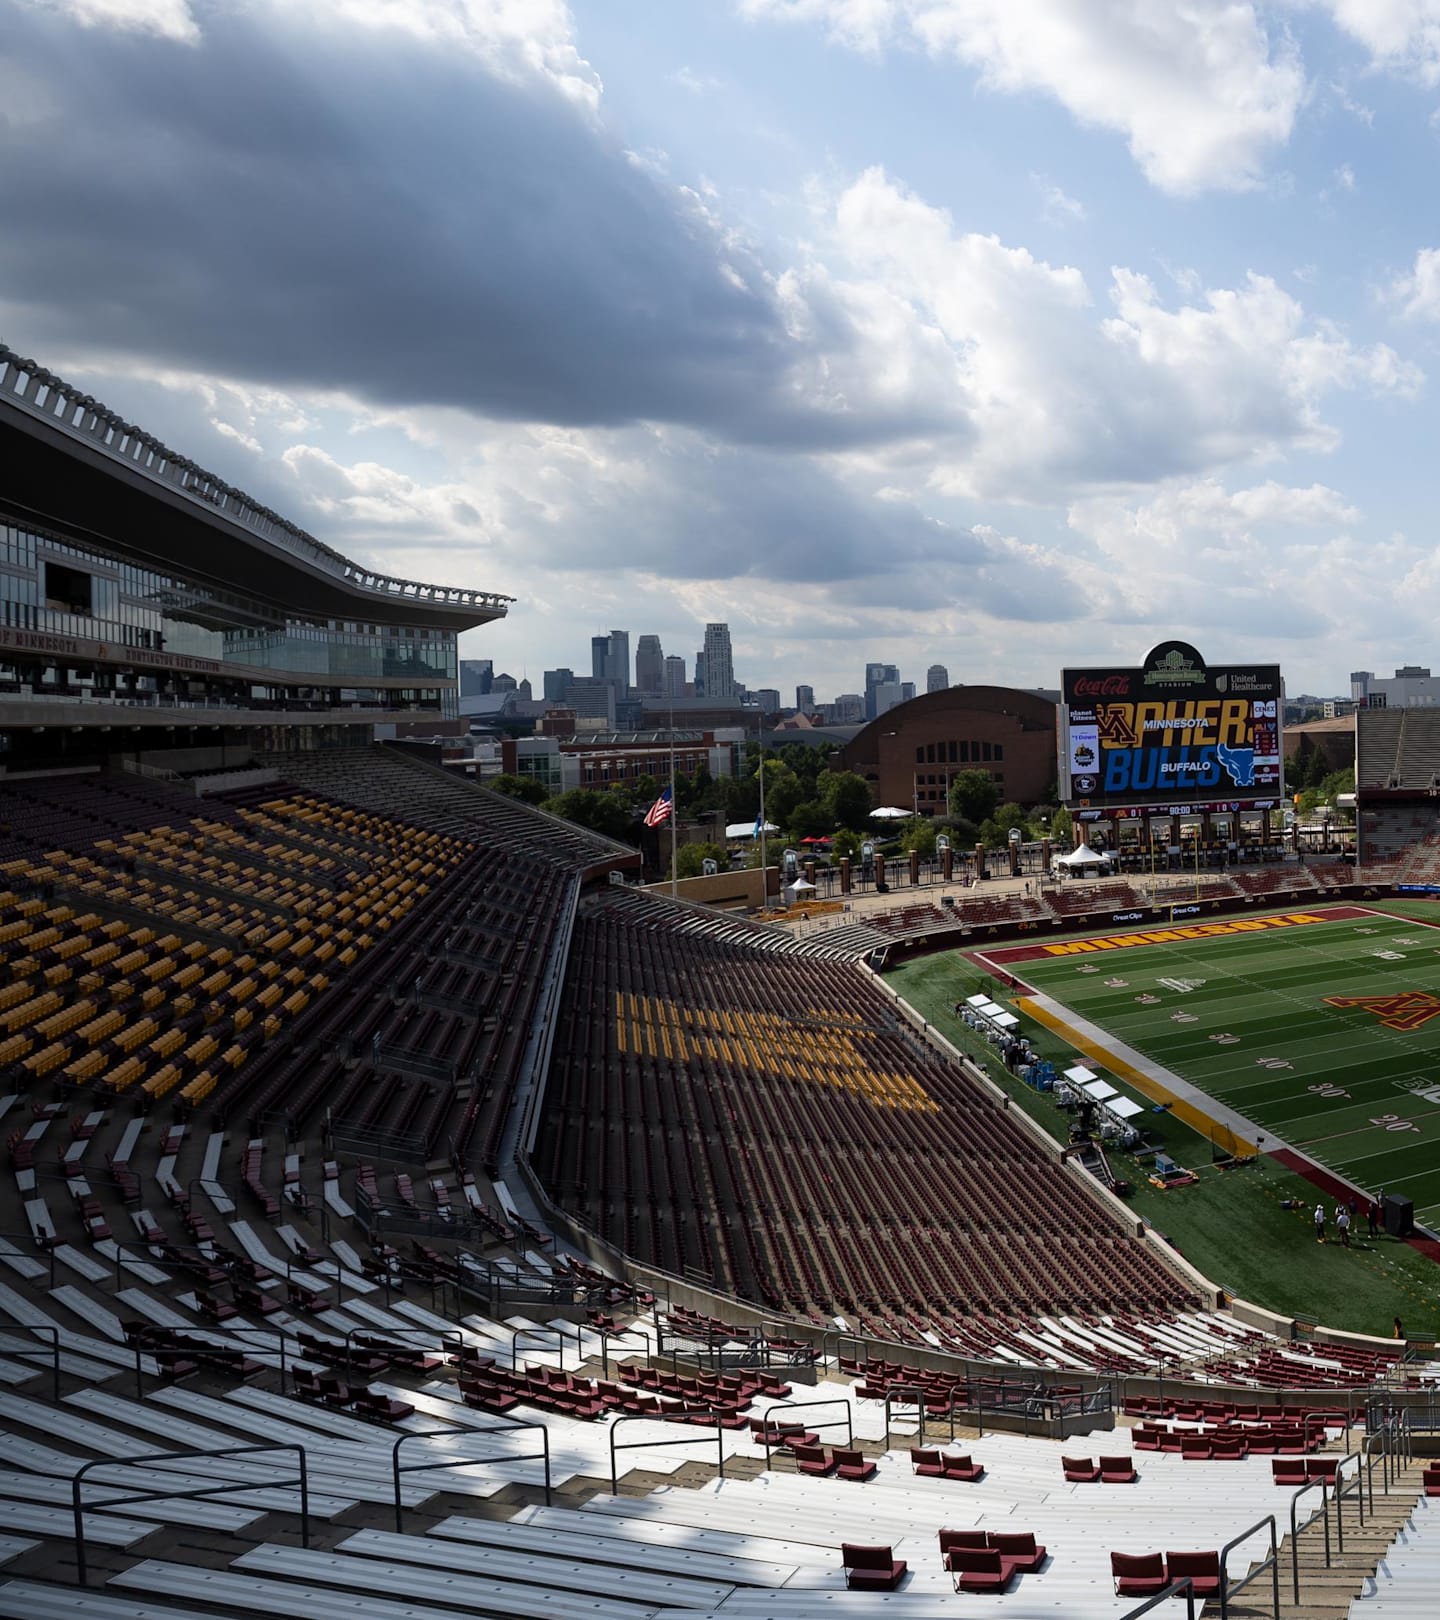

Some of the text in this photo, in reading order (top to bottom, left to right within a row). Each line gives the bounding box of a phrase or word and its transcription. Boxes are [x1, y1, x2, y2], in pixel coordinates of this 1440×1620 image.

[1230, 674, 1257, 683] United
[1074, 675, 1130, 697] Coca-Cola
[1230, 682, 1273, 691] Healthcare
[1069, 710, 1093, 718] planet
[1143, 718, 1209, 730] MINNESOTA
[1104, 745, 1221, 792] BULLS
[1160, 761, 1211, 773] BUFFALO
[1169, 805, 1191, 816] 90:00
[1129, 912, 1143, 920] Clips
[1045, 914, 1328, 956] MINNESOTA
[1255, 1057, 1290, 1070] 40
[1307, 1082, 1346, 1098] 30
[1368, 1114, 1414, 1131] 20
